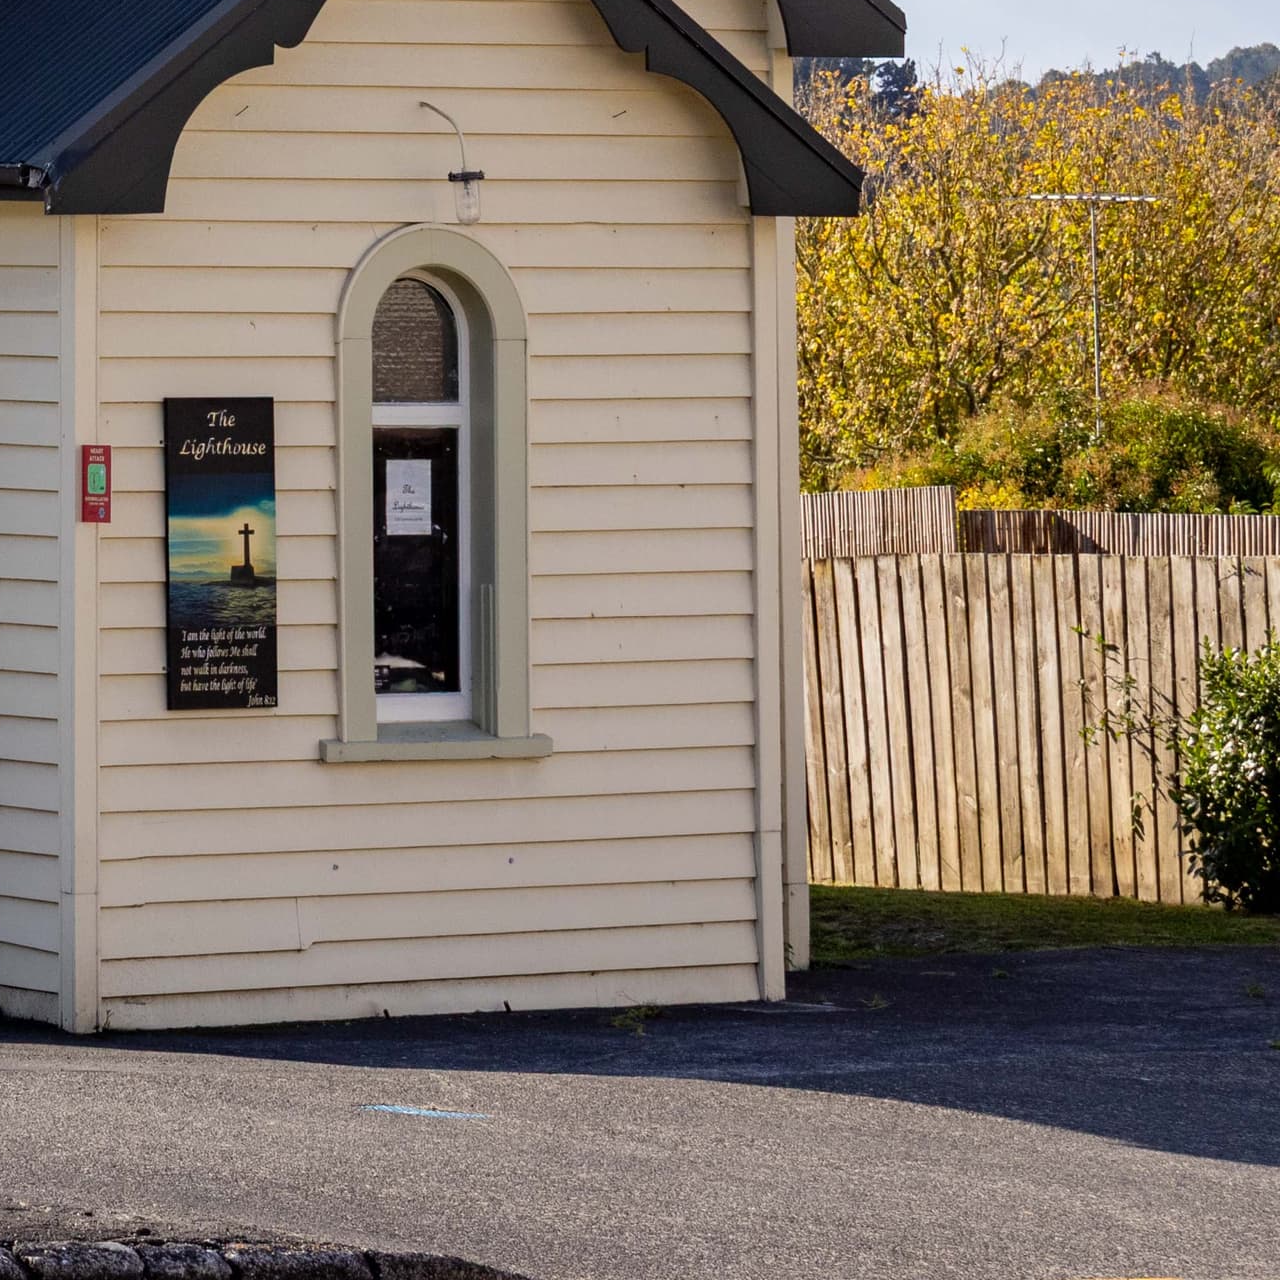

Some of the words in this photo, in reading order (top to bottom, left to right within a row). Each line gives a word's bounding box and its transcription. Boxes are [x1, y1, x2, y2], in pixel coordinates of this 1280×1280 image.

[207, 409, 236, 427] The
[179, 437, 266, 460] Lighthouse
[187, 631, 198, 641] am
[200, 628, 210, 641] the
[211, 628, 226, 644] light
[227, 627, 234, 644] of
[234, 627, 245, 640] the
[181, 646, 191, 658] He
[192, 646, 206, 658] who
[206, 645, 229, 661] follows
[229, 646, 241, 657] Me
[241, 644, 258, 656] shall
[181, 665, 192, 675] not
[193, 662, 209, 675] walk
[210, 664, 217, 675] in
[180, 679, 192, 692] but
[192, 679, 209, 691] have
[210, 678, 220, 691] the
[221, 678, 236, 694] light
[237, 678, 245, 694] of
[246, 693, 263, 707] John
[264, 694, 276, 705] 8:12
